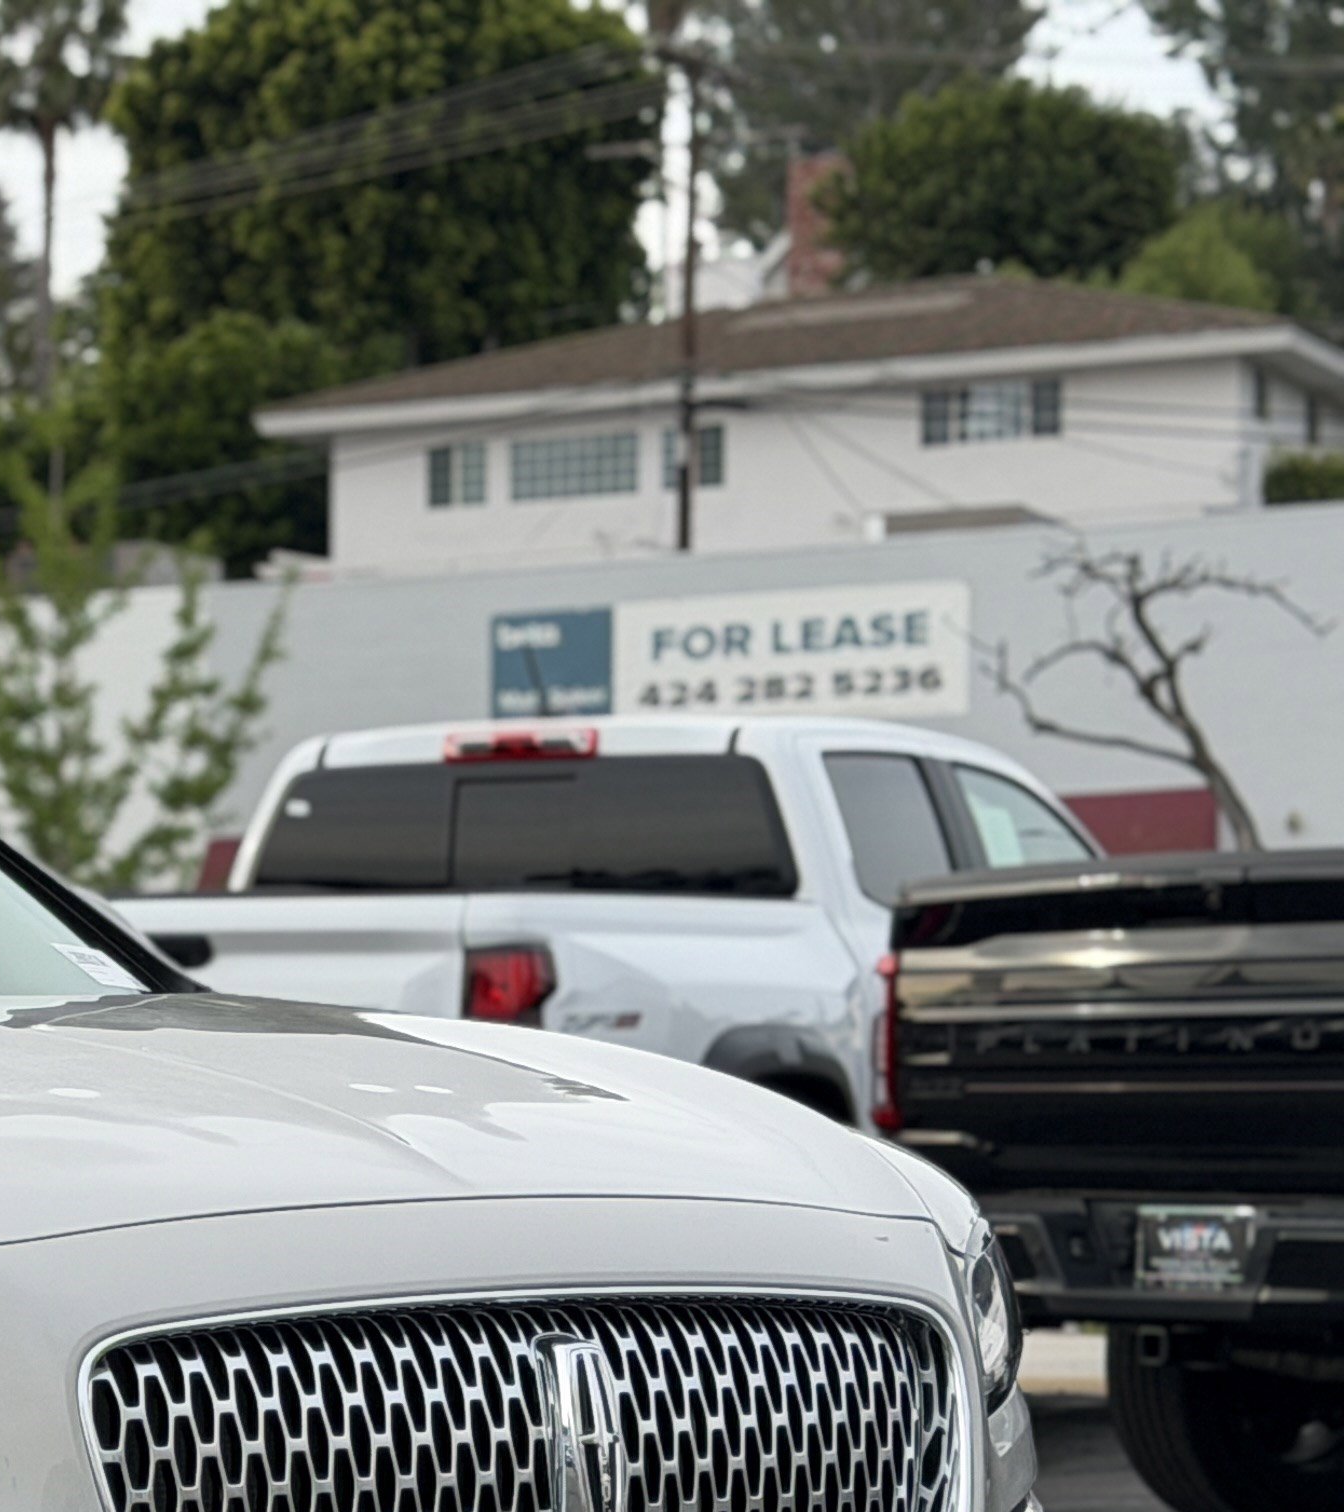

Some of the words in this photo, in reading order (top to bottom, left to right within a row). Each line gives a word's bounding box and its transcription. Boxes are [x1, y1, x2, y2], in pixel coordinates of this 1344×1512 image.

[650, 625, 752, 661] FOR
[771, 611, 930, 653] LEASE
[639, 681, 718, 708] 424
